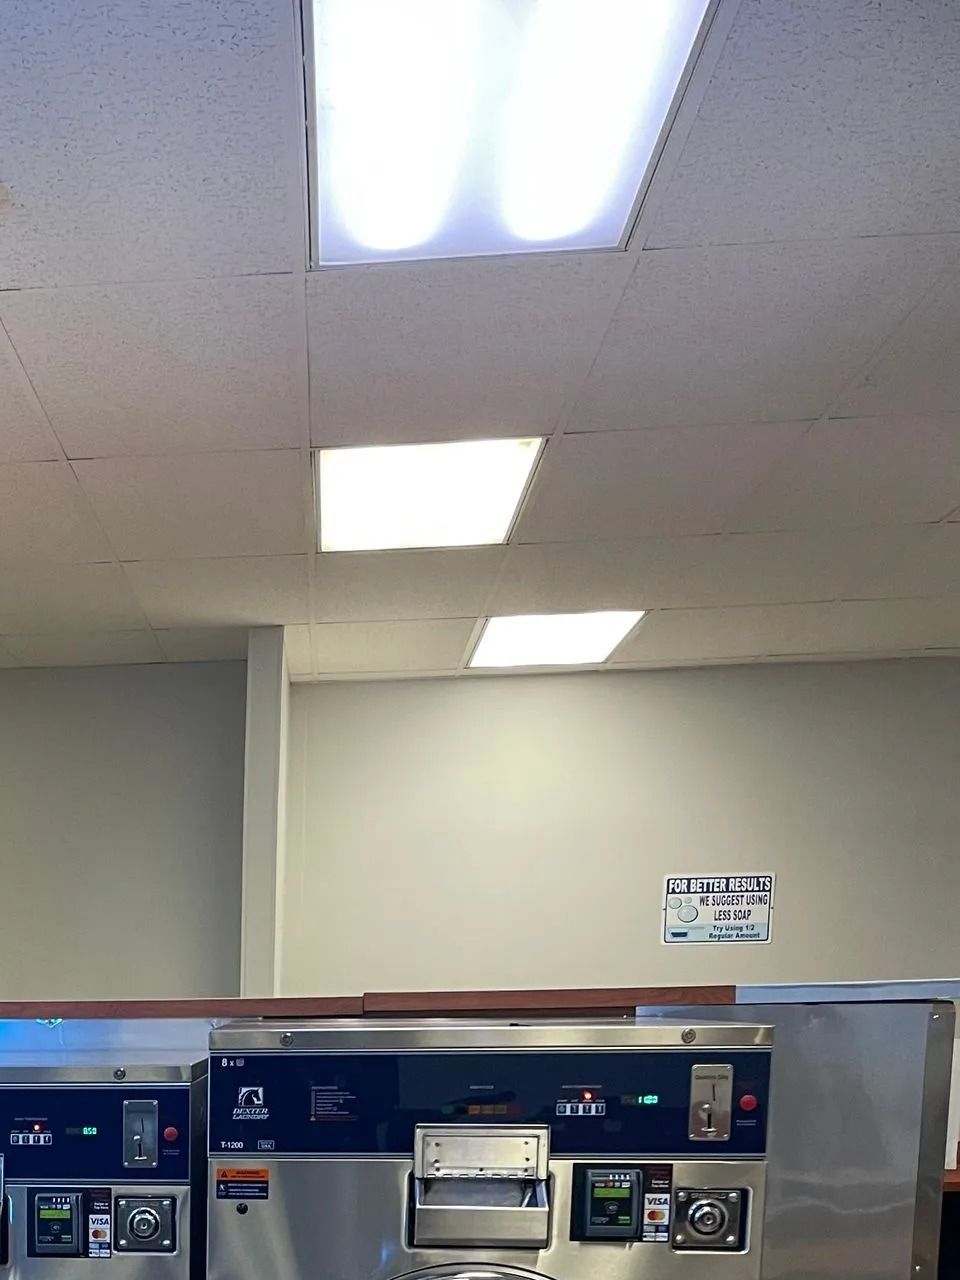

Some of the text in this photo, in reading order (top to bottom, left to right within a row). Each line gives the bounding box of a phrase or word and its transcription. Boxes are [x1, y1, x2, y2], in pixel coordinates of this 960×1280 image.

[669, 877, 771, 893] FOR BETTER RESULTS
[699, 894, 768, 906] WE SUGGEST USING
[714, 909, 752, 921] LESS SOAP
[713, 925, 723, 933] Try
[725, 925, 743, 933] Using
[221, 1058, 228, 1067] 8
[220, 1141, 244, 1149] T-1200
[647, 1197, 669, 1206] VISA
